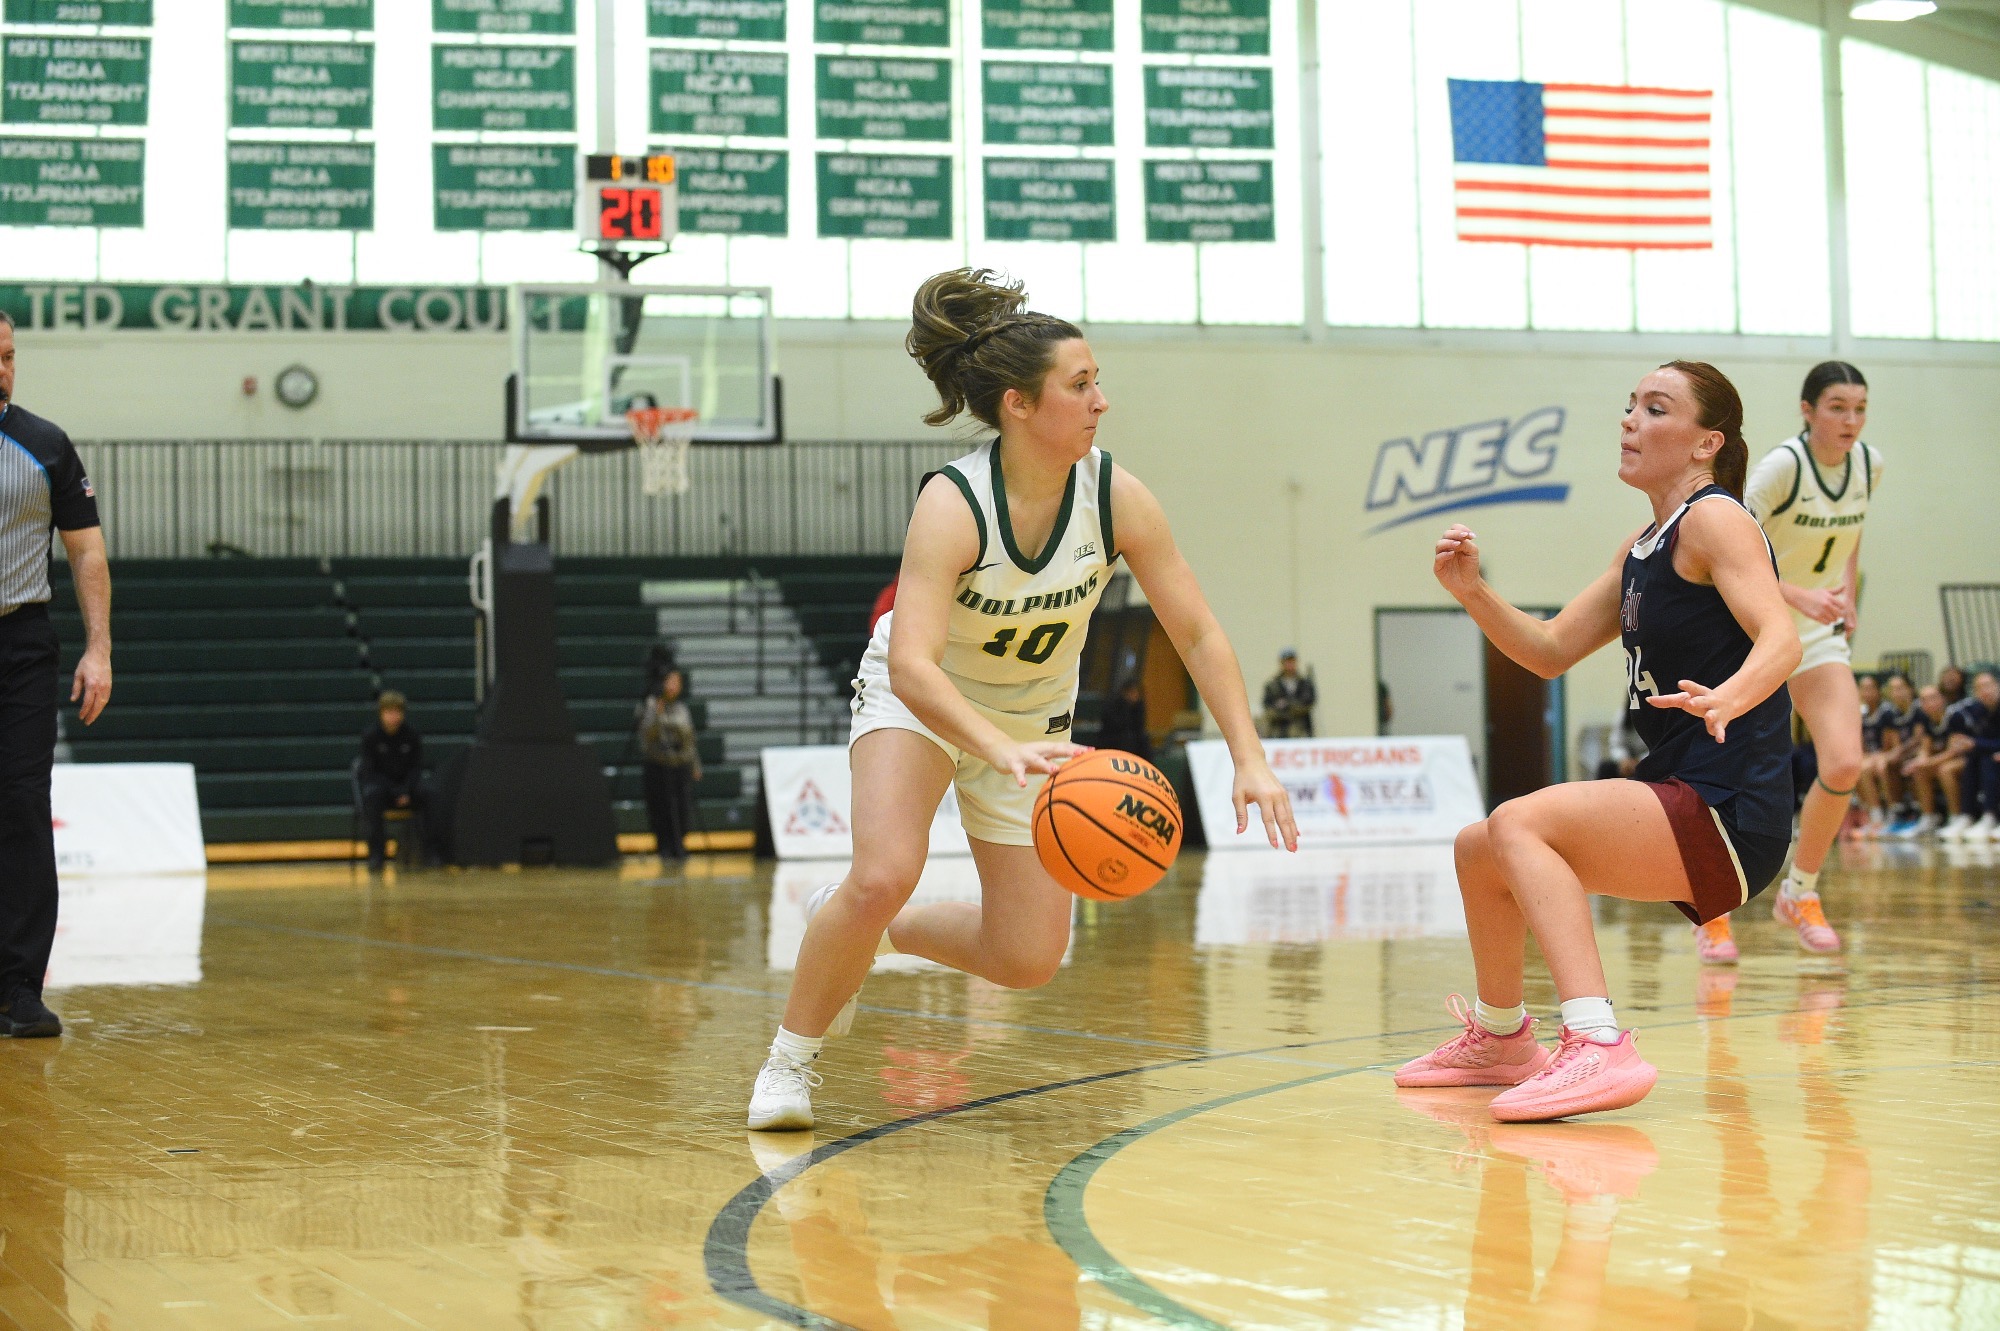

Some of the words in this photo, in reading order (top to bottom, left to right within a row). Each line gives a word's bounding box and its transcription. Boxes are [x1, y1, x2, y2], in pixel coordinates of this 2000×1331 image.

[53, 41, 142, 60] BASKETBALL
[505, 49, 562, 69] GOLF
[45, 60, 106, 80] NCAA
[272, 65, 332, 84] NCAA
[472, 70, 534, 88] NCAA
[6, 82, 145, 102] TOURNAMENT
[683, 74, 754, 93] NCAA
[853, 81, 913, 100] NCAA
[235, 86, 370, 107] TOURNAMENT
[1019, 84, 1077, 104] NCAA
[1180, 89, 1237, 107] NCAA
[818, 99, 949, 120] TOURNAMENT
[38, 162, 100, 182] NCAA
[722, 153, 780, 173] GOLF
[270, 167, 331, 186] NCAA
[474, 168, 536, 187] NCAA
[688, 172, 748, 192] NCAA
[0, 182, 140, 204] TOURNAMENT
[854, 178, 915, 196] NCAA
[1019, 181, 1078, 200] NCAA
[1181, 182, 1238, 201] NCAA
[232, 188, 370, 208] TOURNAMENT
[438, 188, 574, 209] TOURNAMENT
[600, 187, 661, 239] 20
[23, 288, 123, 330] TED
[151, 287, 354, 331] GRANT
[1366, 406, 1566, 513] NEC
[1794, 512, 1865, 528] DOLPHINS
[1073, 541, 1095, 561] NEC
[1813, 536, 1836, 573] 1
[956, 570, 1099, 617] DOLPHINS
[981, 620, 1070, 665] 10
[1115, 793, 1176, 847] NCAA
